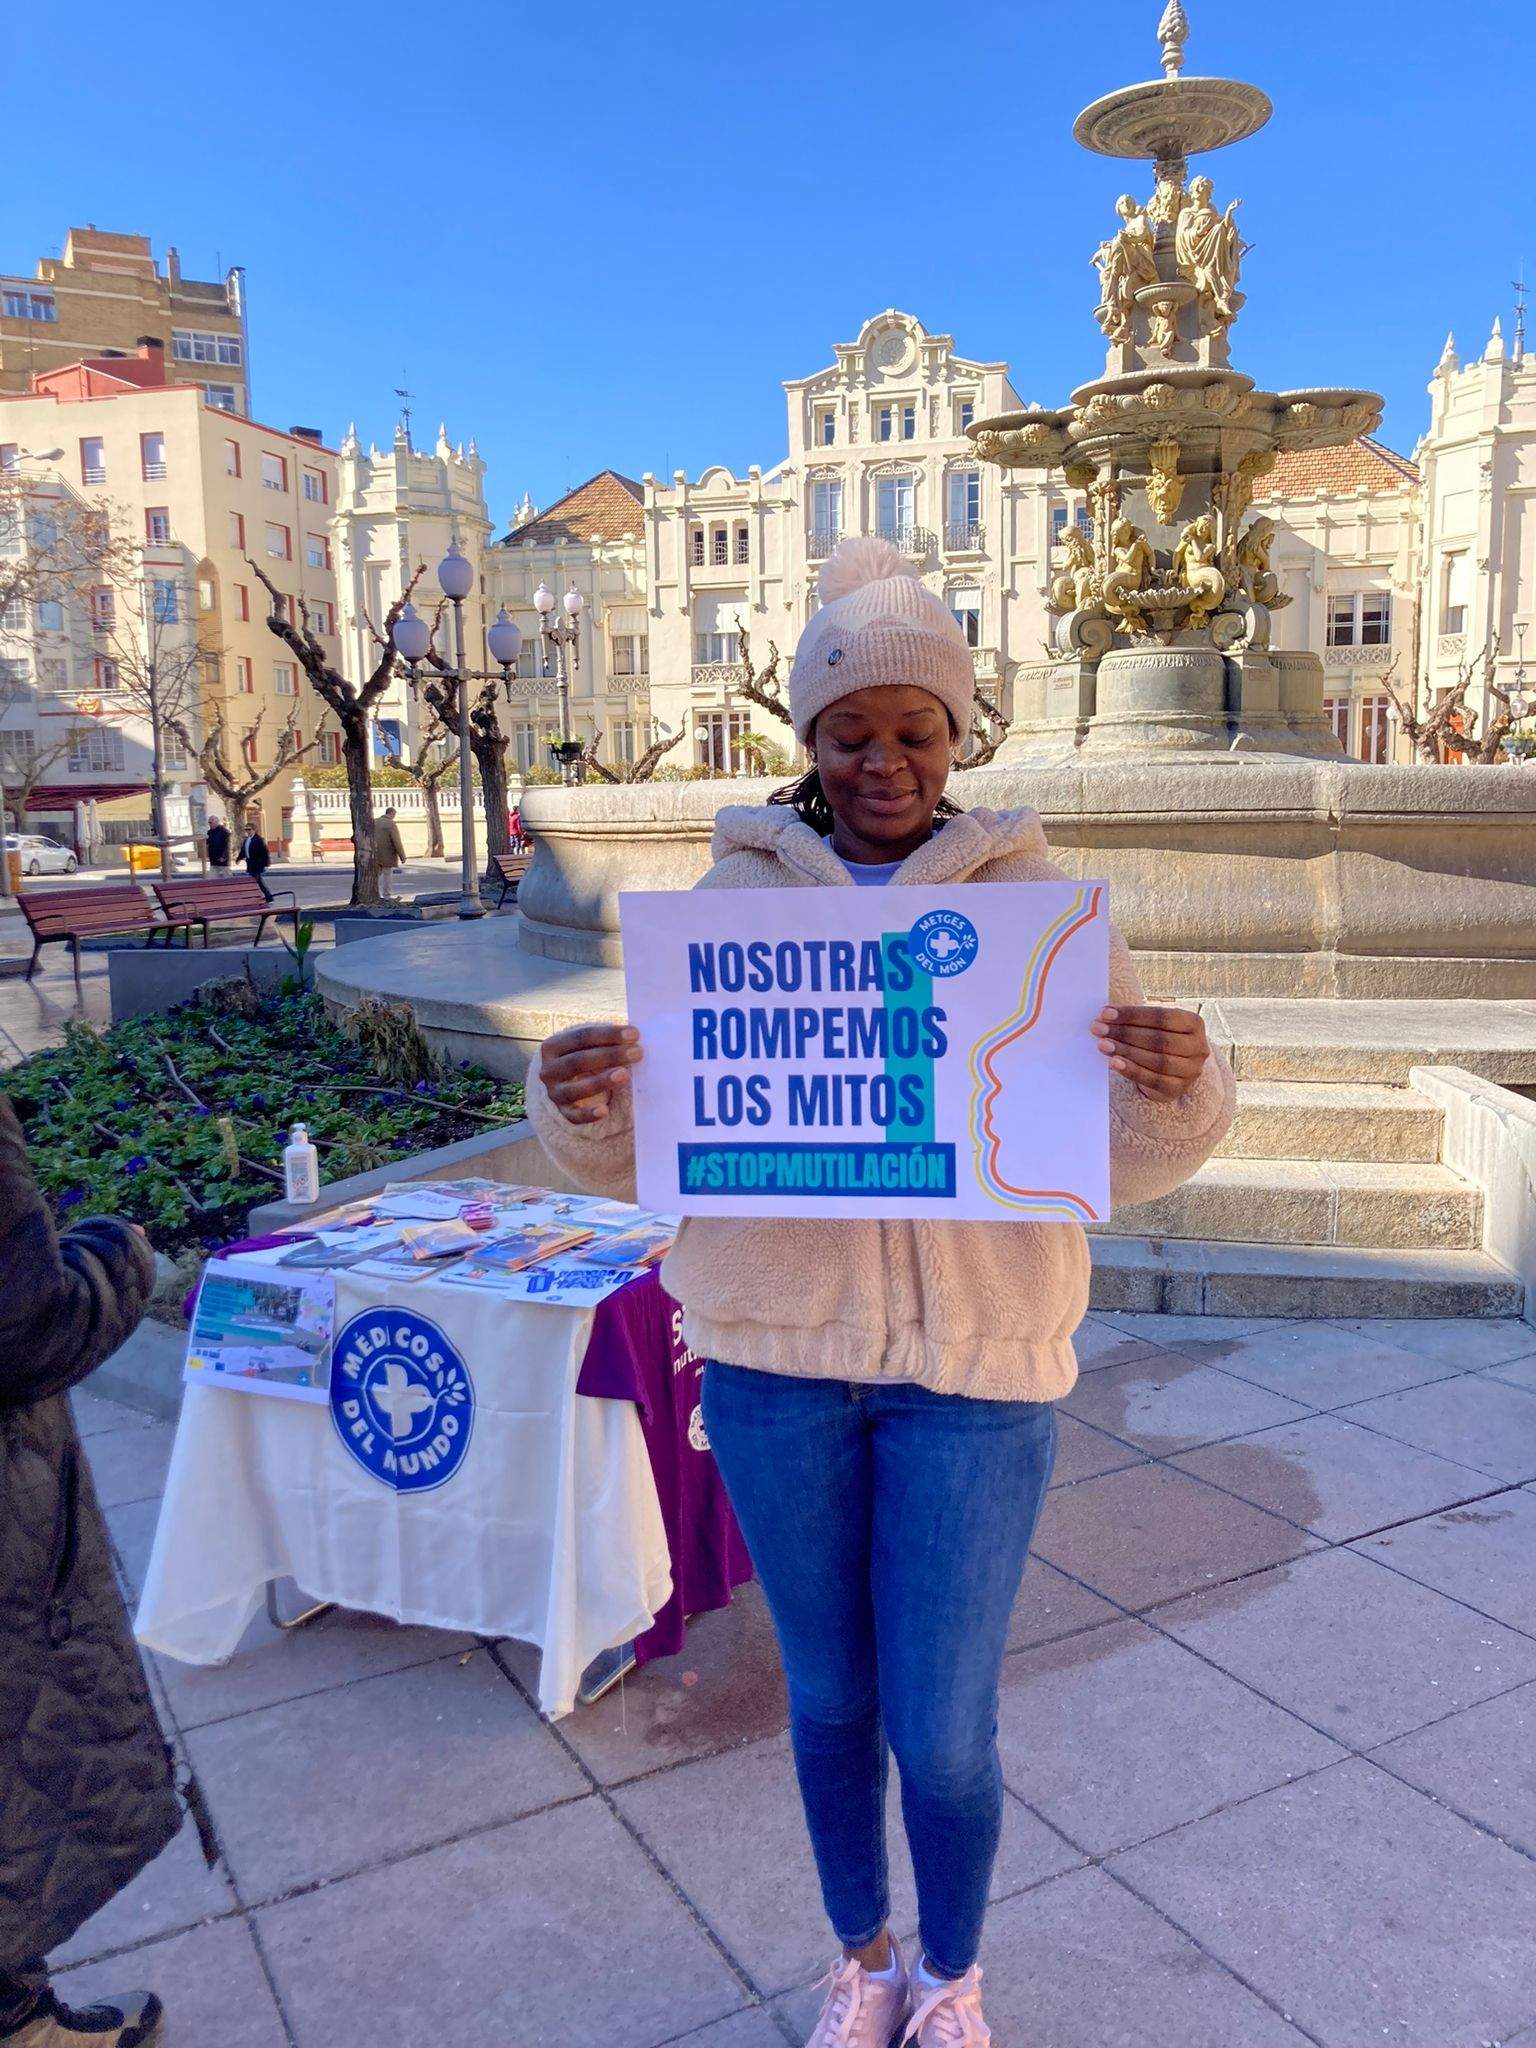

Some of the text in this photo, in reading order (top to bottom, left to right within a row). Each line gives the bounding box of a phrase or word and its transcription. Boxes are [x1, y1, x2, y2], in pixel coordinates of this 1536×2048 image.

[918, 914, 966, 932] METGES
[688, 940, 913, 993] NOSOTRAS
[915, 952, 967, 974] DEL MÓN
[692, 1007, 948, 1060] ROMPEMOS
[693, 1074, 924, 1127] LOS MITOS
[687, 1146, 946, 1189] #STOPMUTILACIÓN
[342, 1398, 375, 1455] DEL
